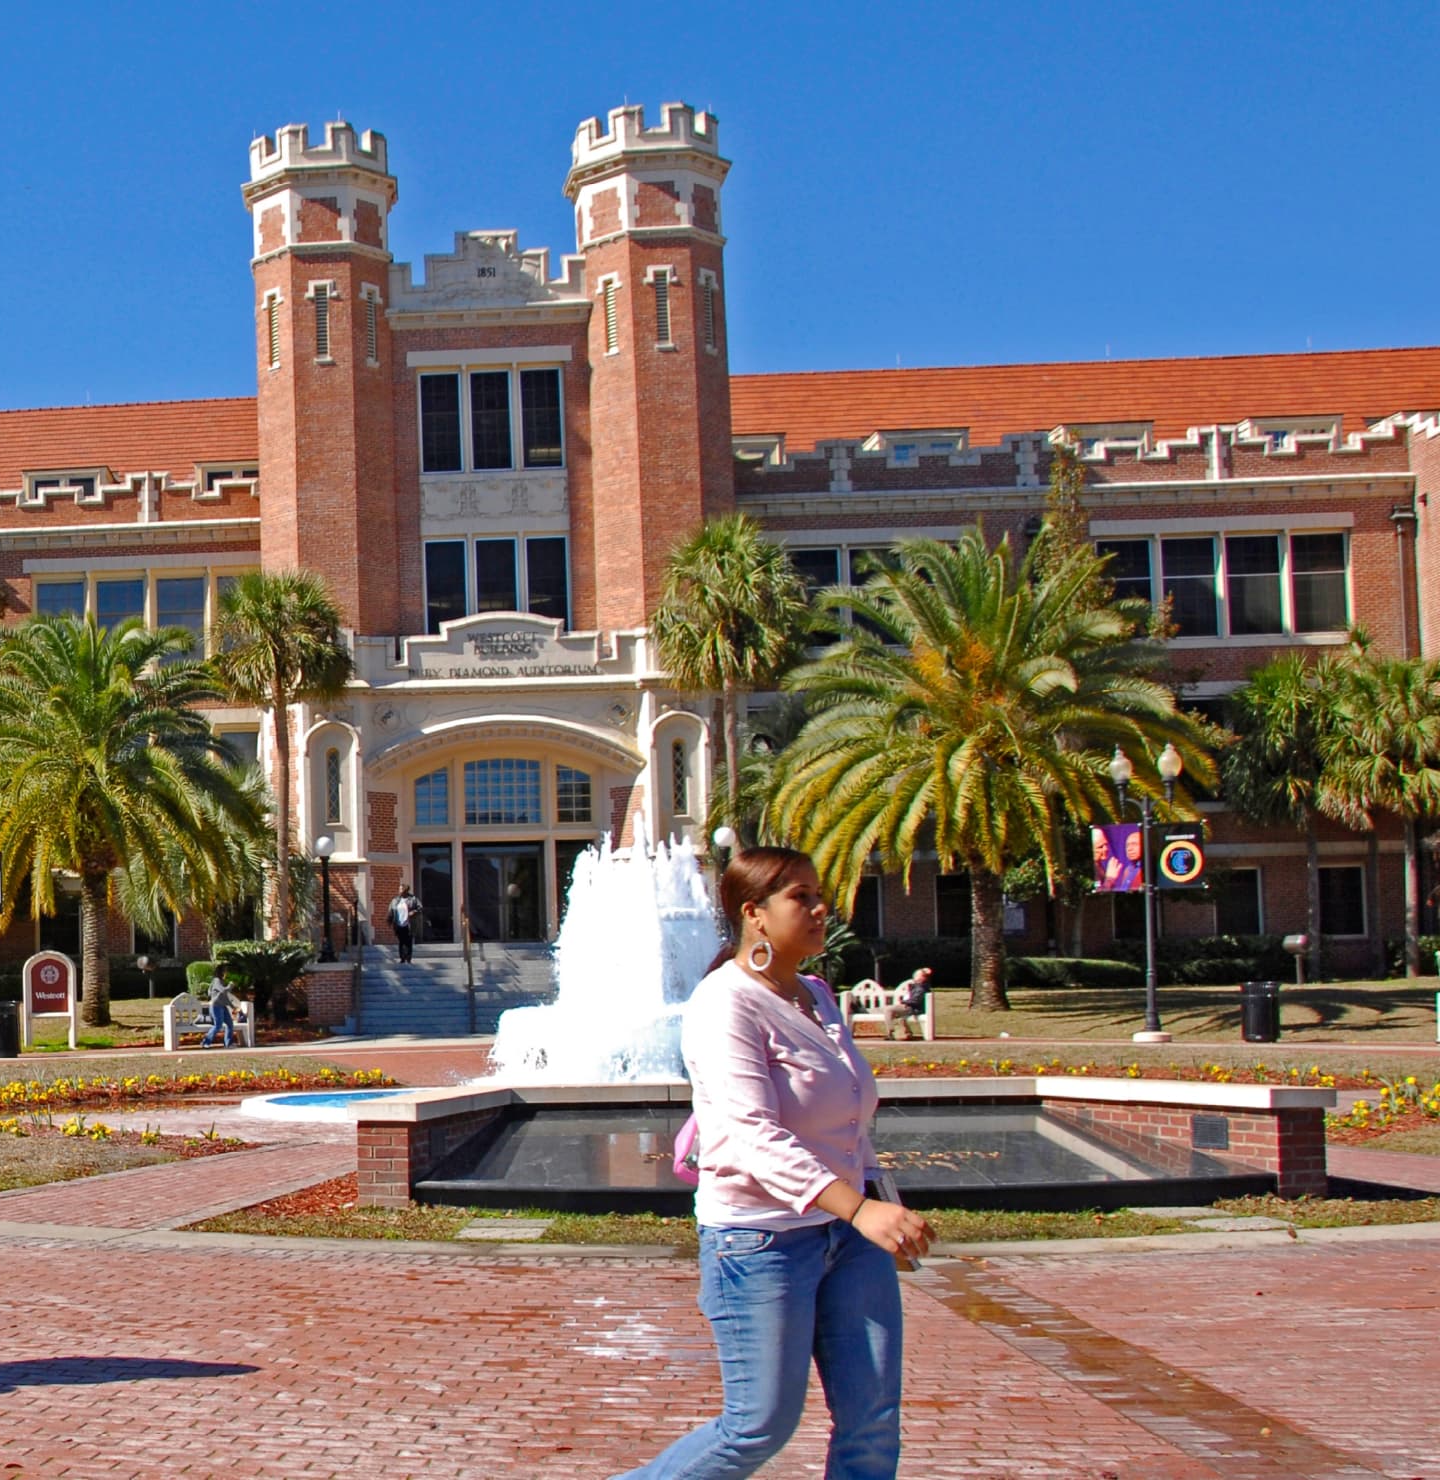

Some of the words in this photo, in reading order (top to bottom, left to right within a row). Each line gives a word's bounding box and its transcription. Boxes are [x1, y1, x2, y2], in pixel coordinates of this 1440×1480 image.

[477, 267, 496, 278] 1851
[467, 631, 537, 642] WESTCOTT
[473, 644, 531, 655] BUILDING
[449, 666, 509, 678] DIAMOND
[517, 664, 598, 676] AUDITORIUM
[35, 991, 65, 1000] Westcott
